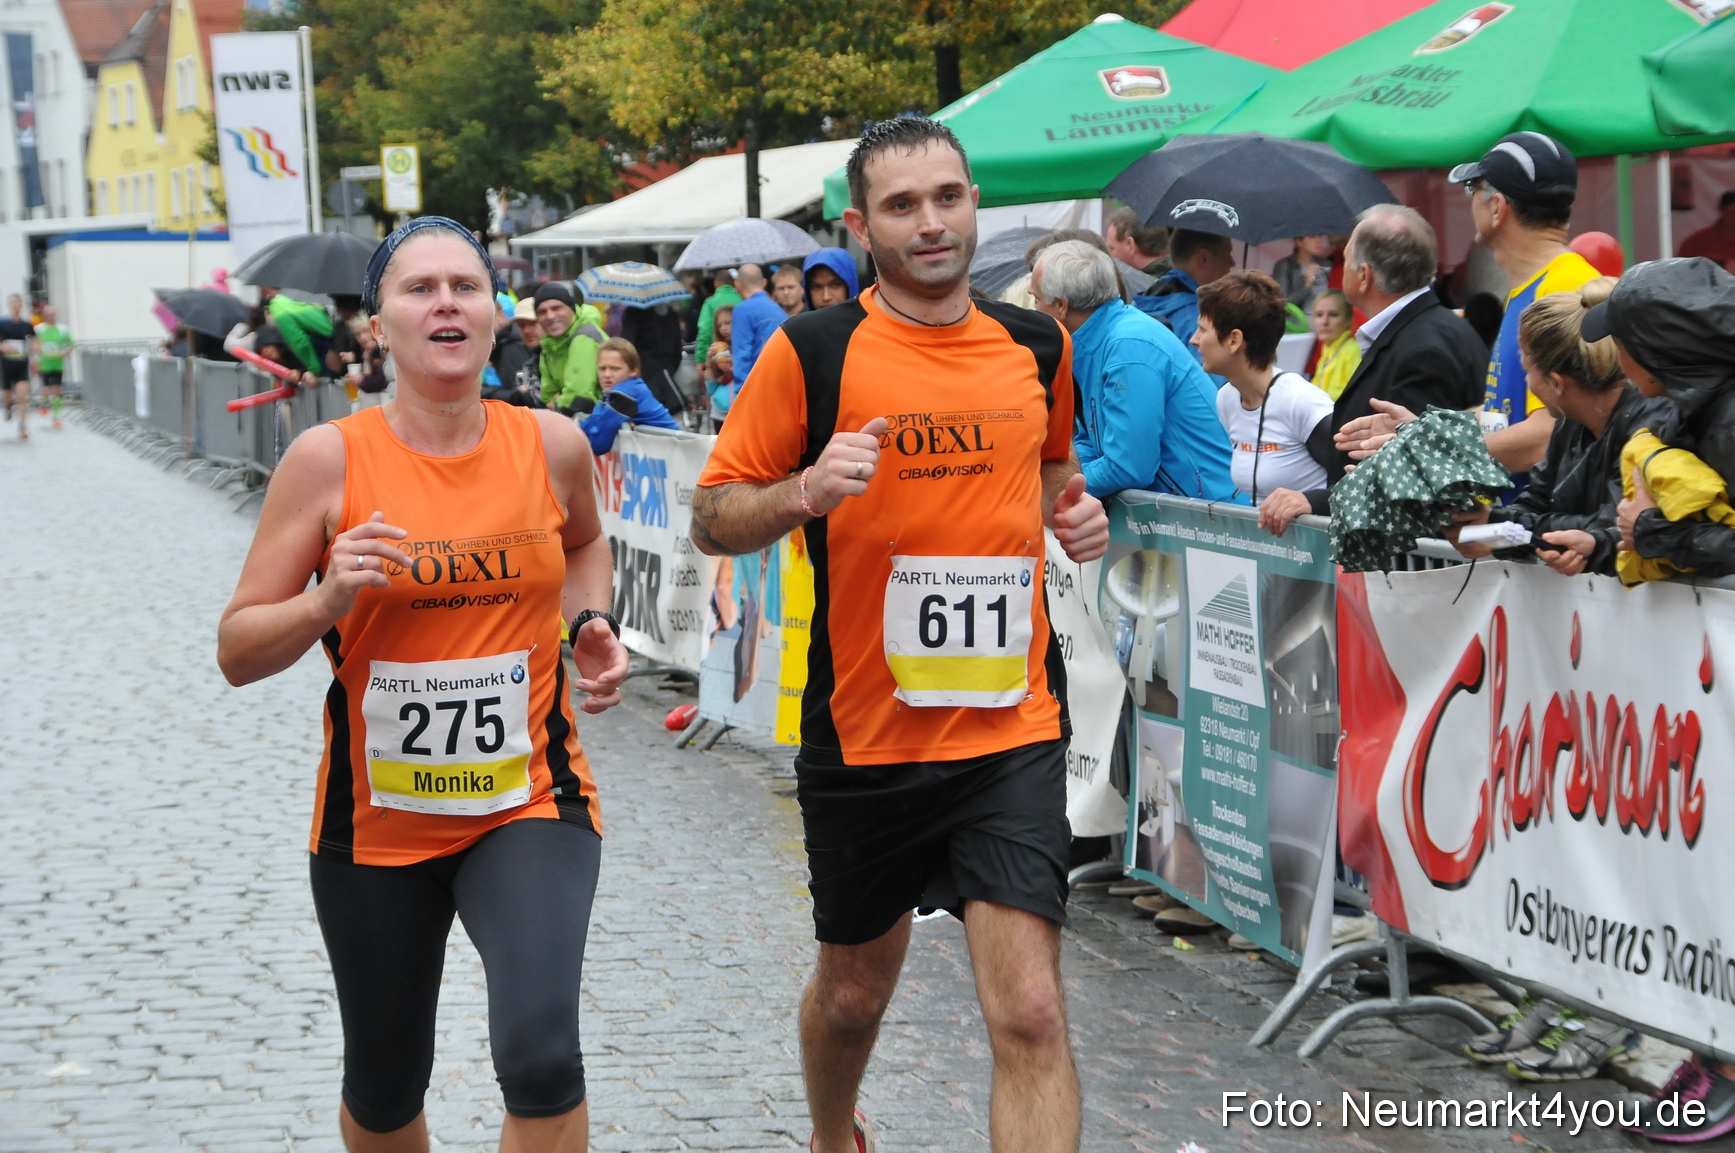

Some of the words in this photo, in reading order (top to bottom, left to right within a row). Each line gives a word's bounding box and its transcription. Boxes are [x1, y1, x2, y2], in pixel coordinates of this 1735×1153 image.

[936, 415, 965, 423] UHREN
[987, 411, 1025, 420] SCHMUCK
[896, 424, 994, 456] OEXL
[899, 468, 932, 480] CIBA
[948, 463, 994, 477] VISION
[456, 538, 489, 550] UHREN
[492, 535, 512, 546] UND
[513, 532, 548, 544] SCHMUCK
[411, 549, 520, 586] OEXL
[891, 571, 941, 585] PARTL
[946, 572, 1016, 585] Neumarkt
[411, 598, 446, 609] CIBA
[466, 592, 520, 607] VISION
[919, 594, 1007, 649] 611
[1196, 621, 1223, 647] MATHI
[1224, 627, 1256, 656] HOFFER
[370, 677, 421, 693] PARTL
[426, 672, 505, 692] Neumarkt
[399, 696, 505, 756] 275
[1200, 715, 1218, 736] 92318
[372, 749, 380, 758] D
[1403, 605, 1716, 890] Charivari
[414, 771, 494, 793] Monika
[1211, 800, 1247, 829] Trockenbau
[1506, 877, 1655, 975] Ostbayerns
